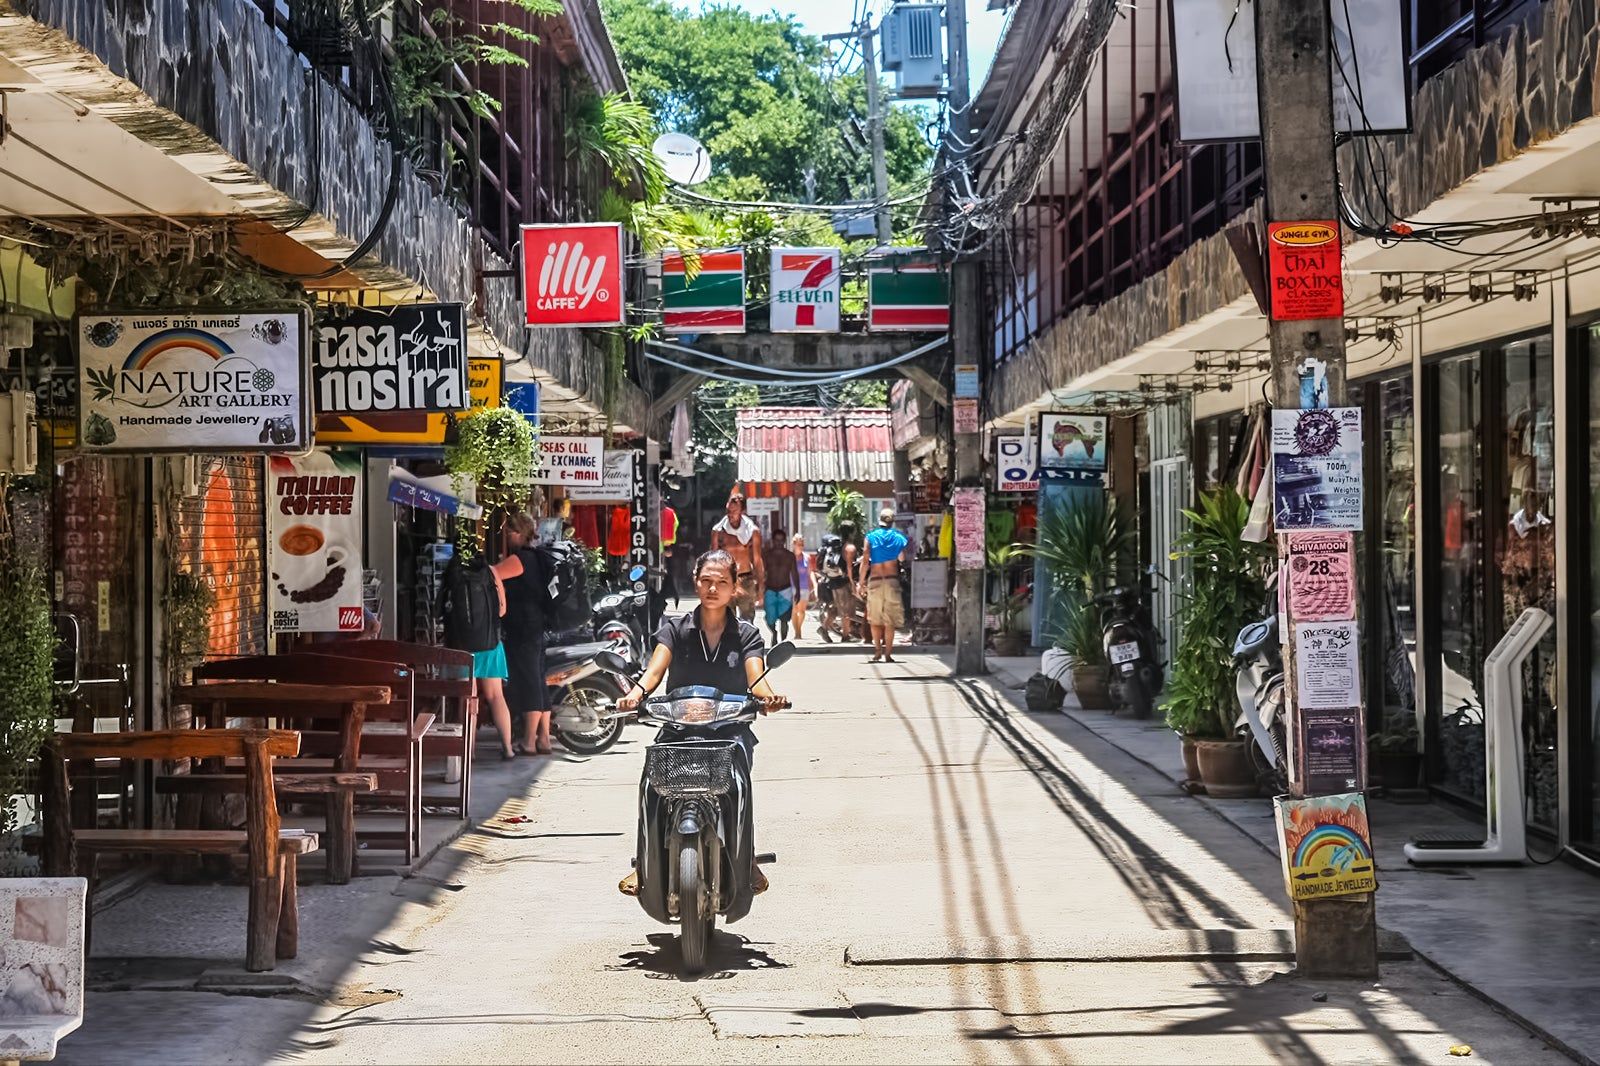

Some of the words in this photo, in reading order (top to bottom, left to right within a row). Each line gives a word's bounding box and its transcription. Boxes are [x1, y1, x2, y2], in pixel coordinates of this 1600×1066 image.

[1312, 230, 1330, 238] GYM
[538, 241, 607, 310] illy
[1276, 275, 1340, 290] BOXING
[781, 255, 833, 326] 7
[1286, 289, 1332, 298] CLASSES
[319, 325, 397, 368] casa
[121, 371, 251, 394] NATURE
[320, 351, 463, 411] nostra
[178, 394, 212, 408] ART
[216, 394, 293, 407] GALLERY
[119, 415, 192, 426] Handmade
[196, 414, 260, 426] Jewellery
[569, 442, 589, 454] CALL
[551, 455, 597, 468] EXCHANGE
[560, 470, 599, 481] E-MAIL
[276, 475, 356, 496] ITALIAN
[280, 495, 354, 516] COFFEE
[1292, 542, 1346, 552] SHIVAMOON
[1309, 560, 1330, 576] 28
[340, 610, 361, 629] illy
[1295, 882, 1334, 897] HANDMADE
[1335, 878, 1373, 892] JEWELLERY
